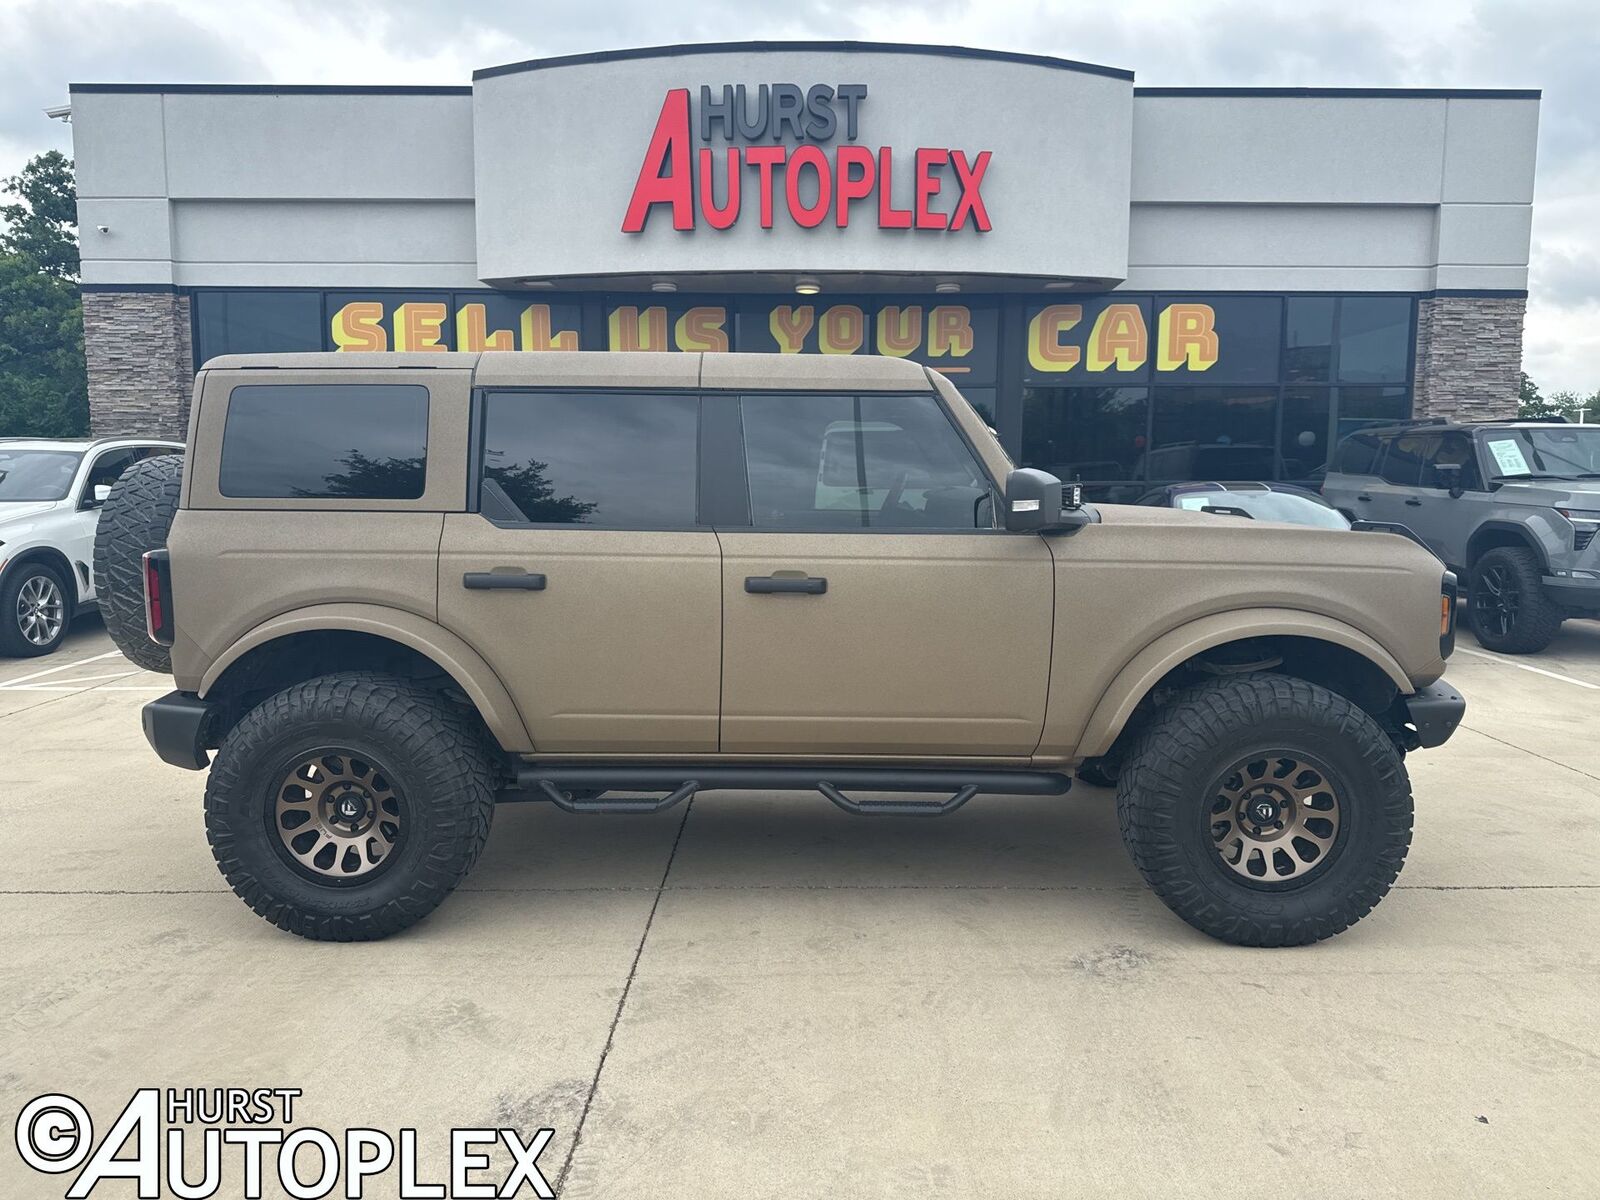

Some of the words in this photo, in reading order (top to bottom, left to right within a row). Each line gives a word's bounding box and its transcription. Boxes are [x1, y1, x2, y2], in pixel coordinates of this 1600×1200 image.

[701, 84, 867, 141] HURST
[621, 88, 993, 233] AUTOPLEX
[331, 302, 579, 352] SELL
[608, 305, 729, 353] US
[769, 305, 974, 357] YOUR
[1028, 303, 1219, 372] CAR
